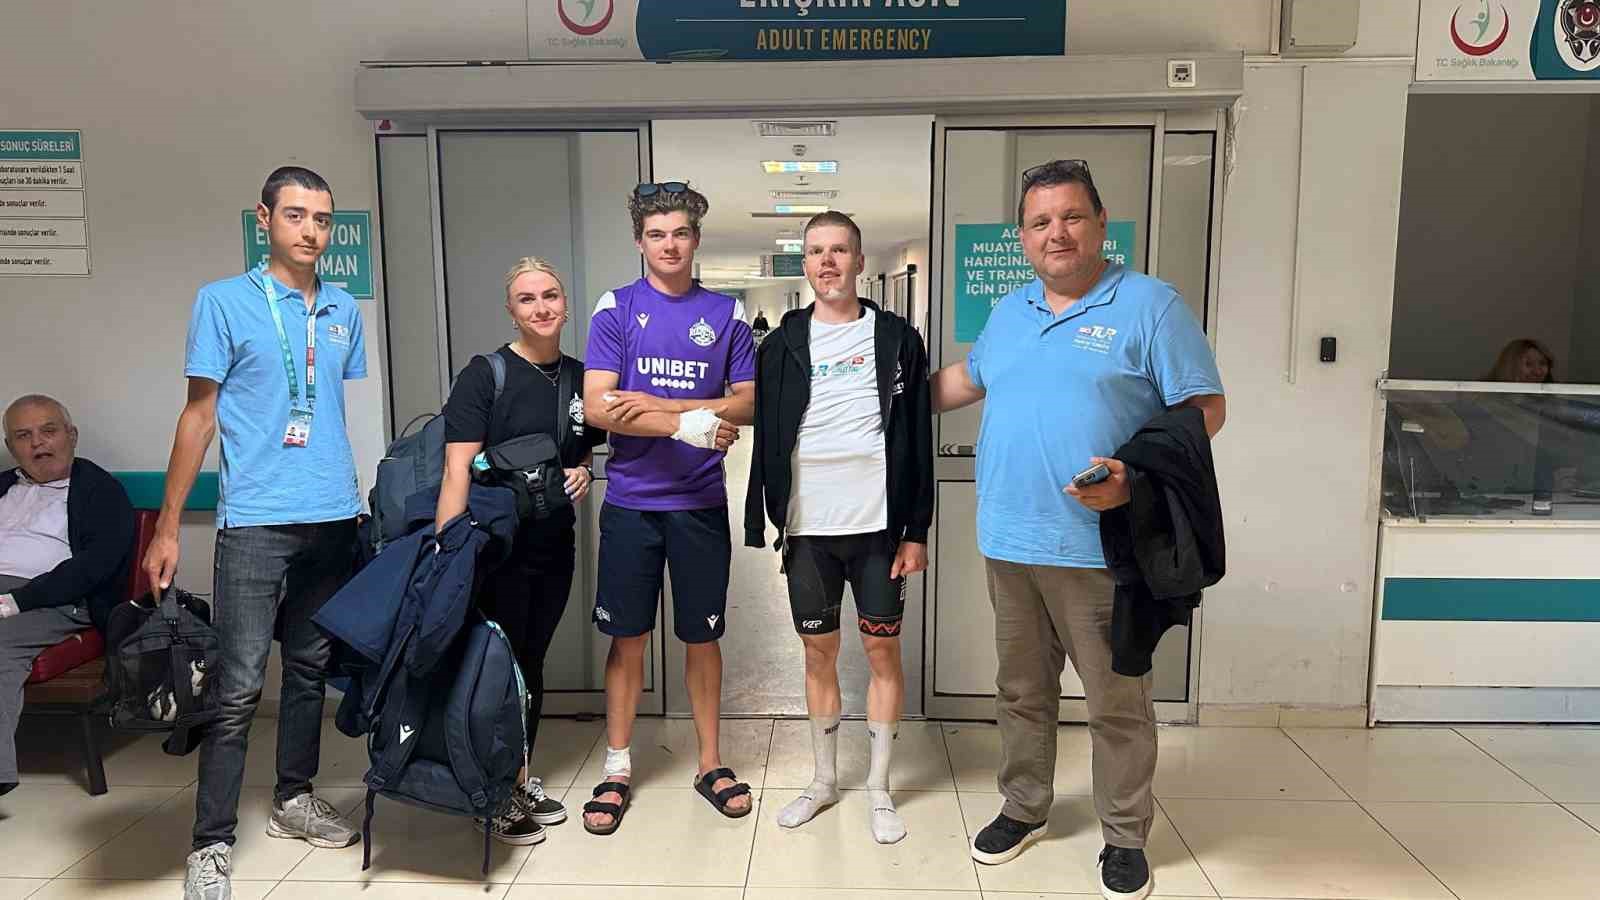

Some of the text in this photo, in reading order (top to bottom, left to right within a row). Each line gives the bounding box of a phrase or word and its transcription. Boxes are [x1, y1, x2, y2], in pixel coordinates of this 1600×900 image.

[756, 28, 932, 50] ADULT EMERGENCY
[0, 138, 74, 153] SONUÇ SÜRELERİ
[973, 242, 1023, 253] MUAYE
[967, 269, 1038, 281] VE TRANS
[966, 281, 994, 296] İÇİN
[637, 357, 709, 379] UNIBET
